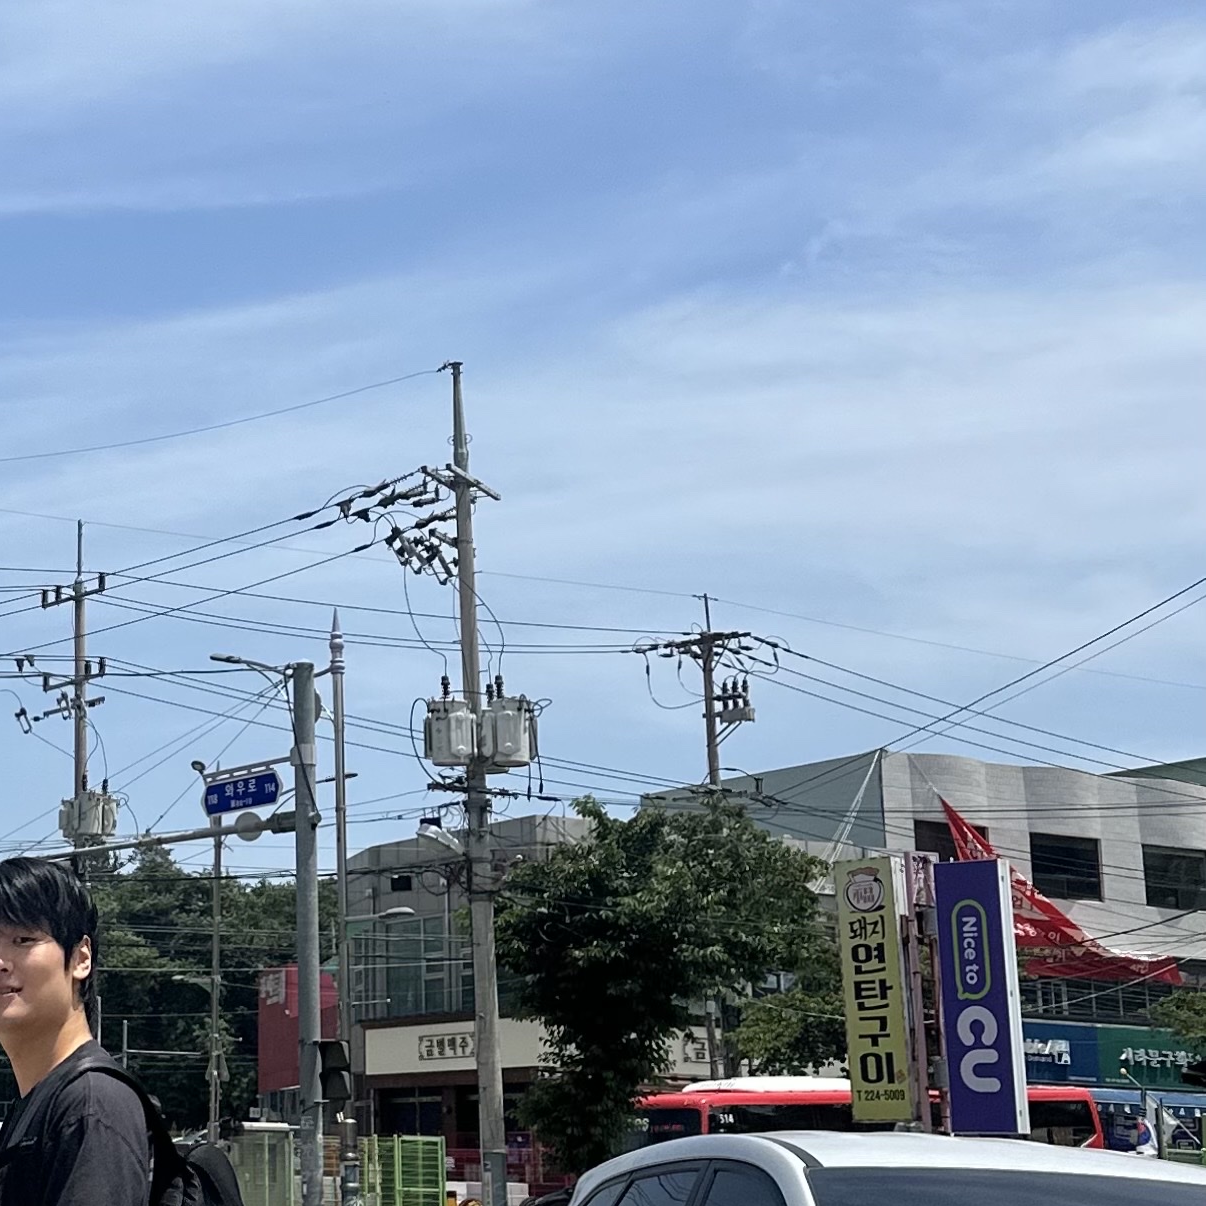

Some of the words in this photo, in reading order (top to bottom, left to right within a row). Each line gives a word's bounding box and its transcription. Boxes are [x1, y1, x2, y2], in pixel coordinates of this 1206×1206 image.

[224, 779, 257, 797] 와우로
[848, 914, 886, 941] 돼지
[961, 916, 978, 960] Nice
[965, 965, 980, 985] to
[851, 942, 895, 1084] 연탄구이
[956, 1005, 1001, 1093] CU
[864, 1089, 905, 1101] 224-5009
